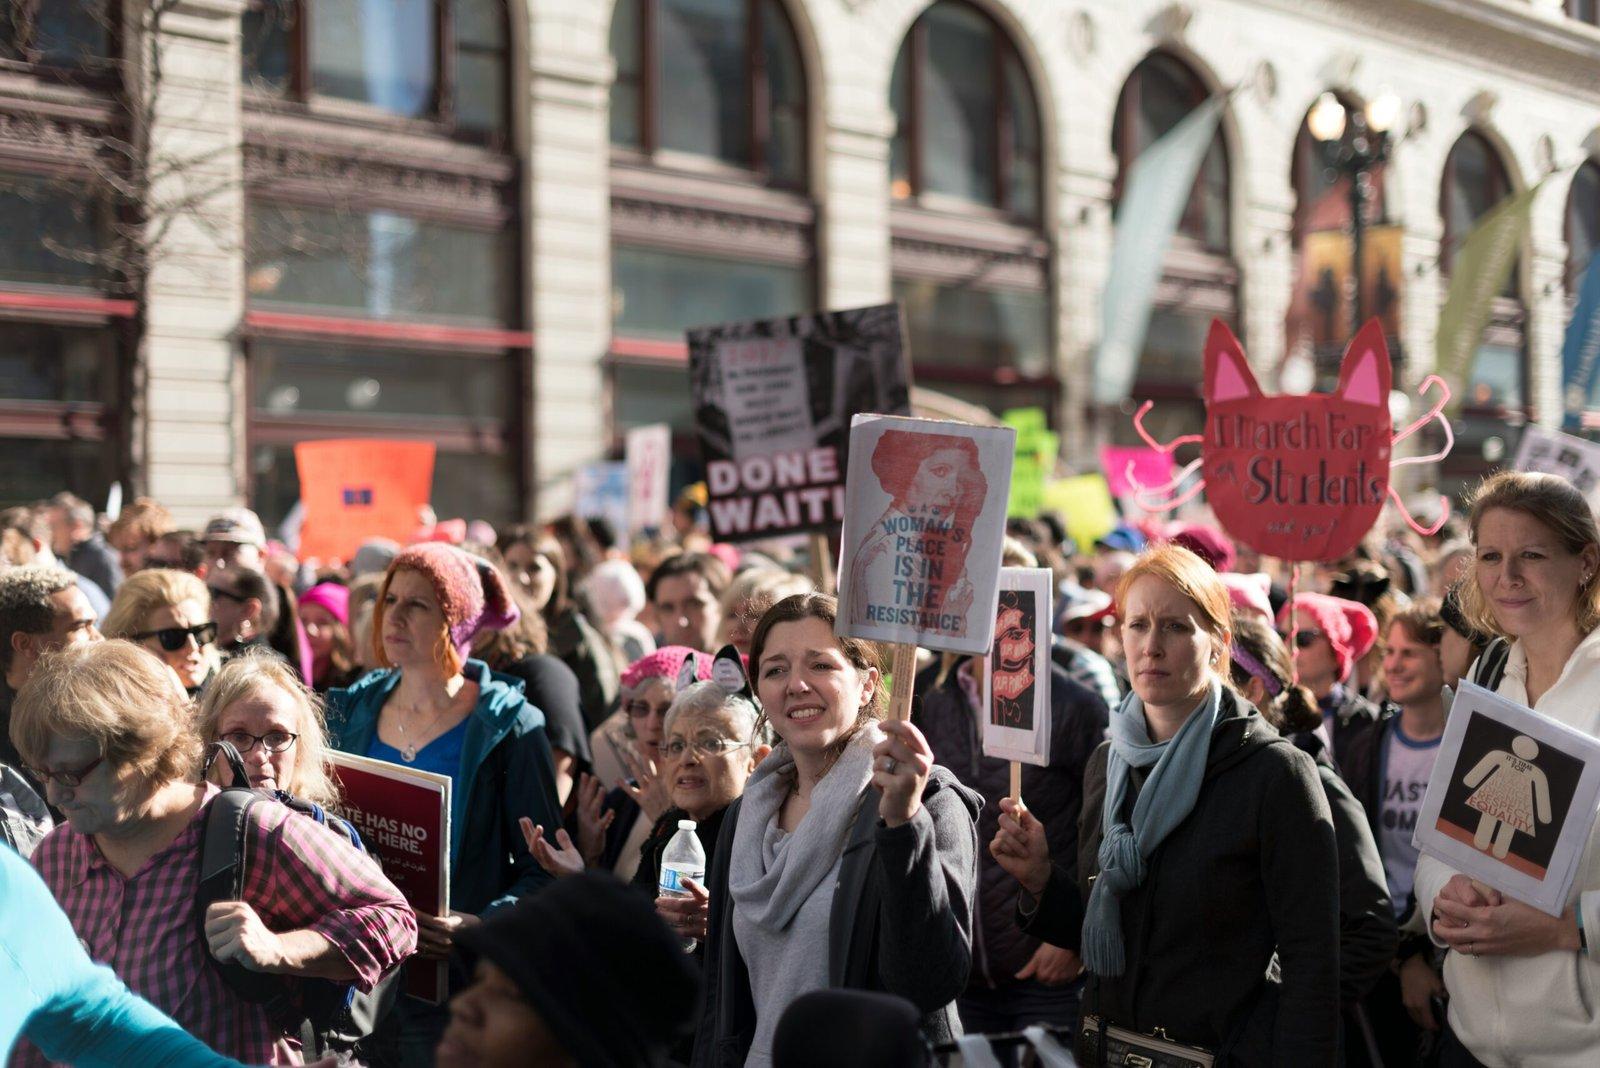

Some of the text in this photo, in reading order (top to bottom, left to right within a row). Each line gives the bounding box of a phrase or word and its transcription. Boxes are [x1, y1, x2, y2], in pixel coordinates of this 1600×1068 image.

[1234, 412, 1321, 450] March
[707, 446, 839, 496] DONE
[1243, 453, 1384, 506] Students
[882, 516, 965, 542] WOMAN'S
[896, 536, 946, 556] PLACE
[894, 555, 943, 580] IS IN
[893, 580, 942, 609] THE
[866, 604, 962, 631] RESISTANCE
[1511, 763, 1526, 773] FOR
[1469, 796, 1533, 832] EQUALITY
[1478, 790, 1531, 819] RESPECT
[367, 814, 397, 832] HAS
[402, 823, 427, 841] NO
[379, 832, 423, 855] HERE.
